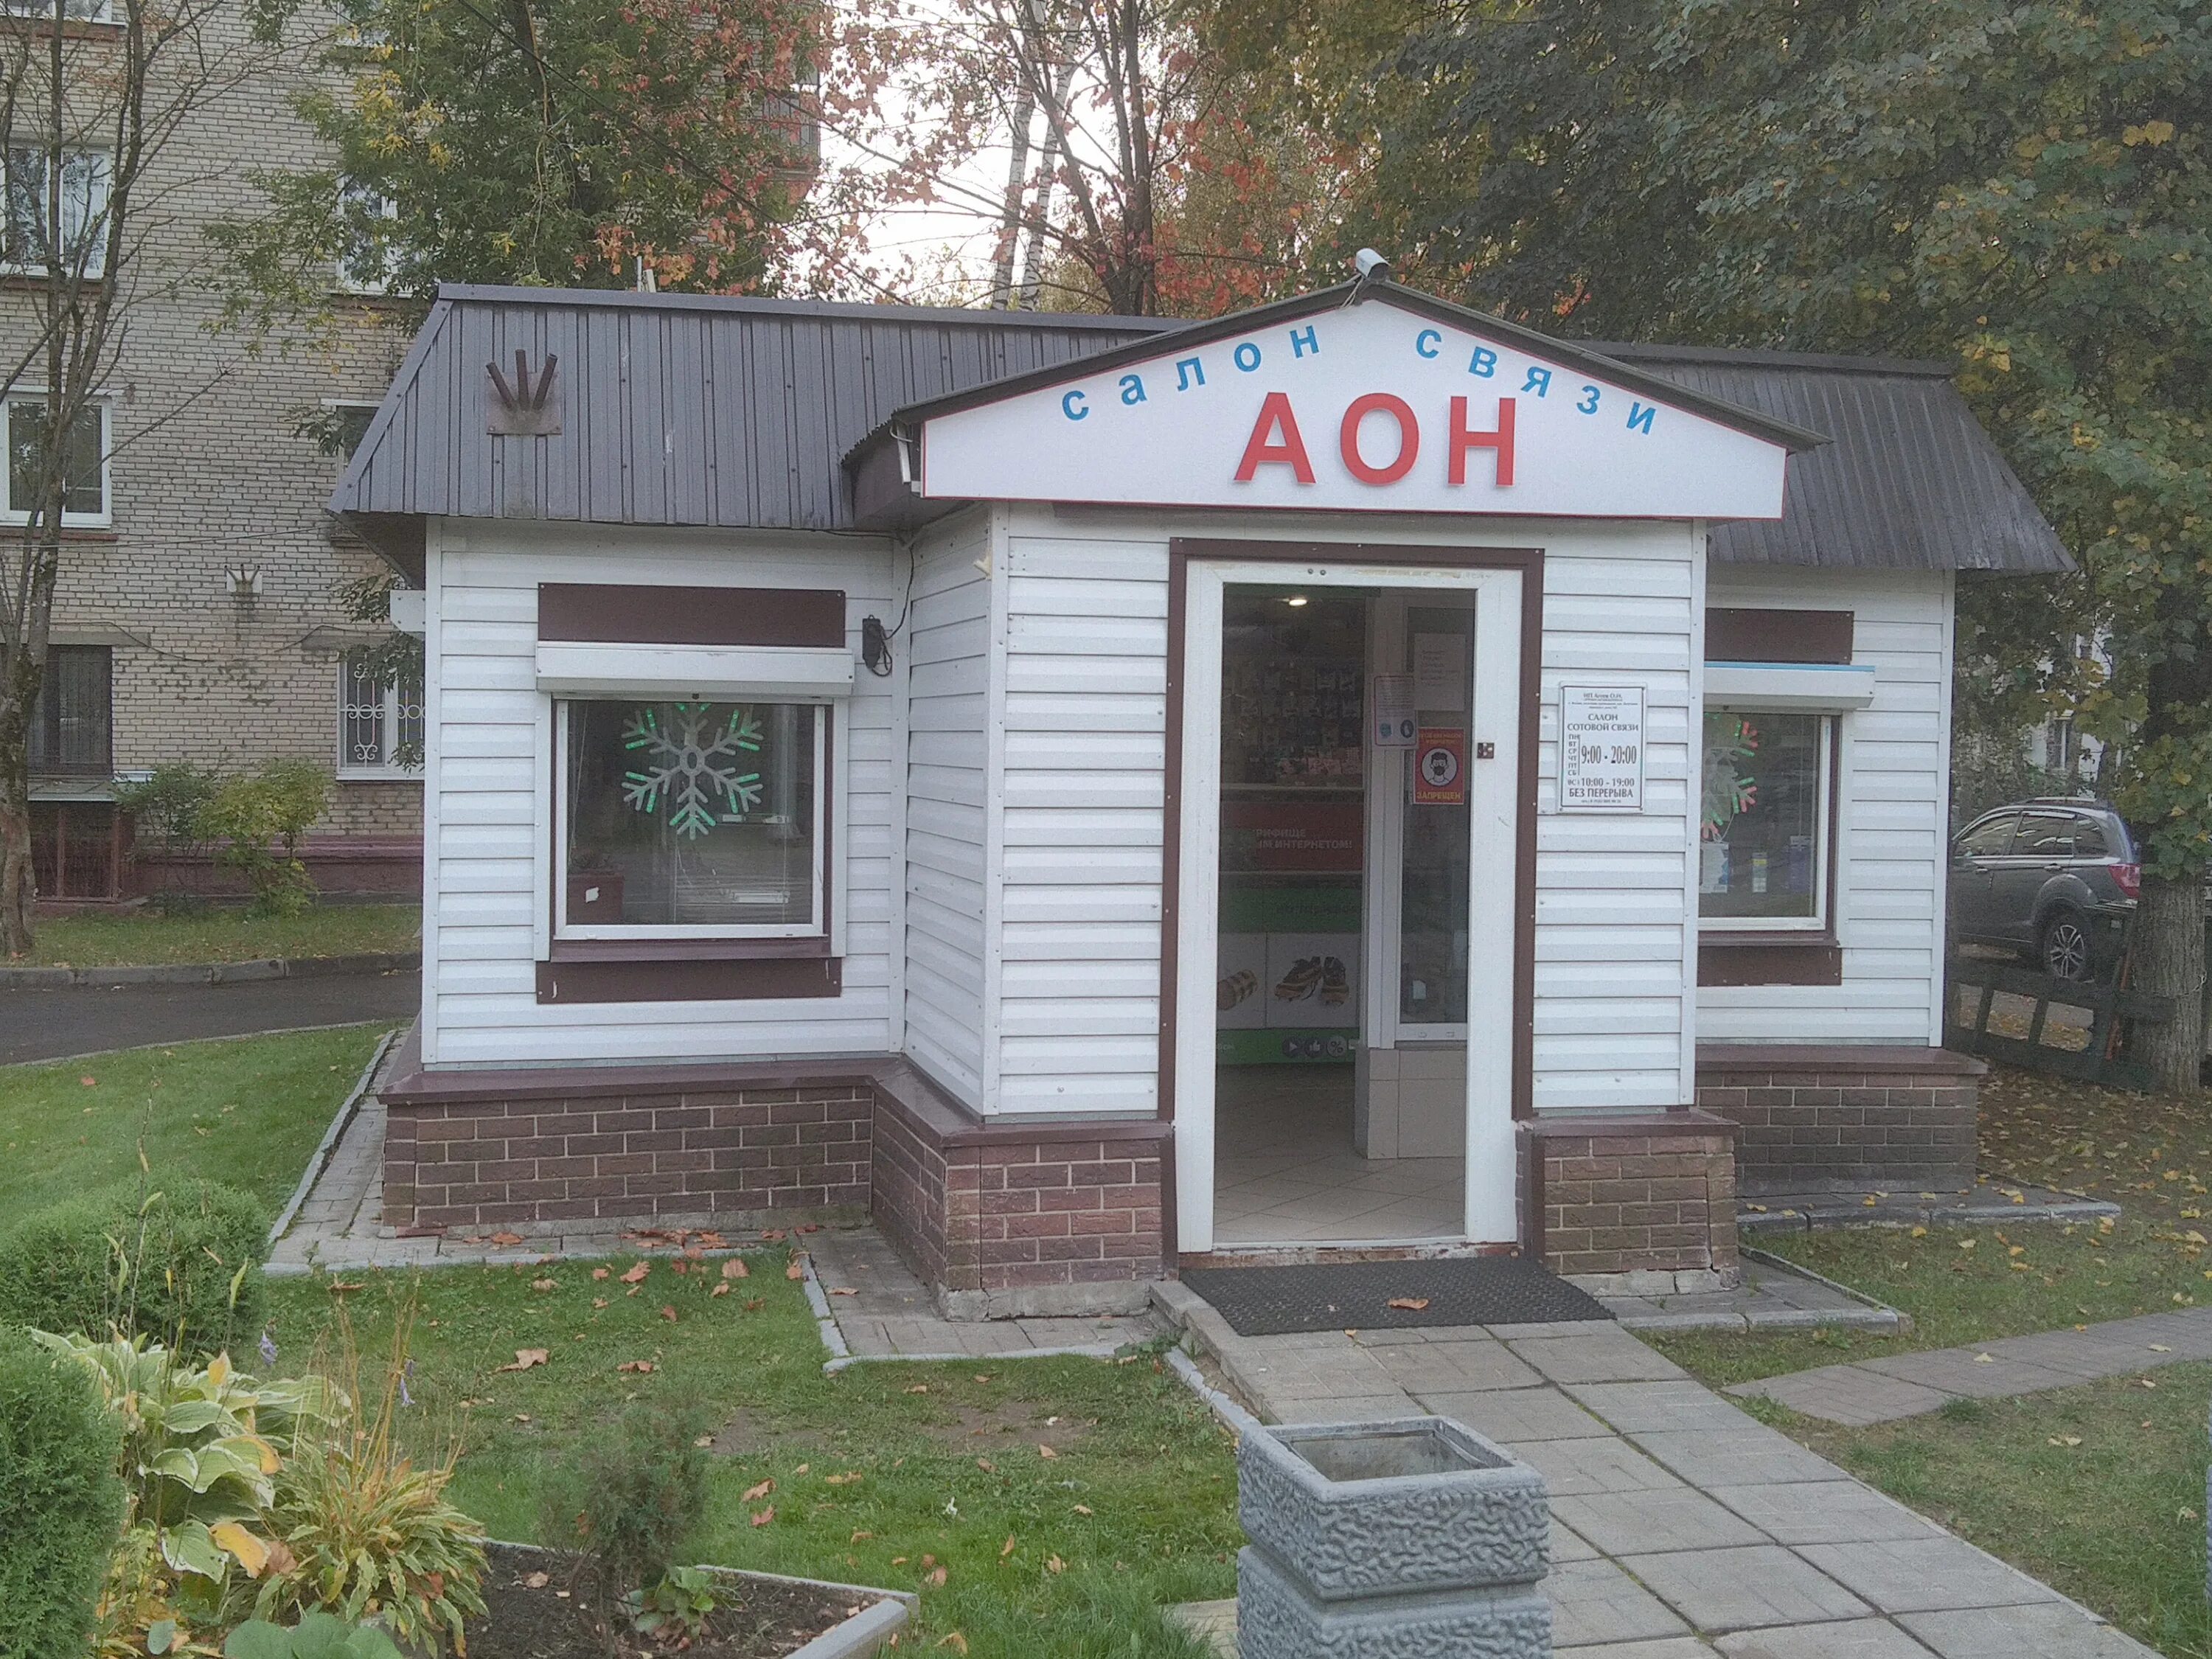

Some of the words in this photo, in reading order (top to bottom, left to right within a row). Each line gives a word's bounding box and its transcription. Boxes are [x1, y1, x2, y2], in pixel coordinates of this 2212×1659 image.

[1062, 325, 1320, 420] салон
[1416, 330, 1656, 435] связи
[1234, 392, 1517, 487] АОН
[1587, 713, 1618, 721] САЛОН
[1567, 723, 1610, 731] СОТОВОЙ
[1611, 723, 1639, 731] СВЯЗИ
[1581, 745, 1601, 764] 9:00
[1610, 745, 1637, 765] 20:00
[1581, 777, 1604, 787] 10:00
[1612, 778, 1635, 787] 19:00
[1416, 790, 1461, 801] ЗАПРЕЩЕН
[1569, 787, 1585, 798] БЕЗ
[1587, 788, 1633, 799] ПЕРЕРЫВА
